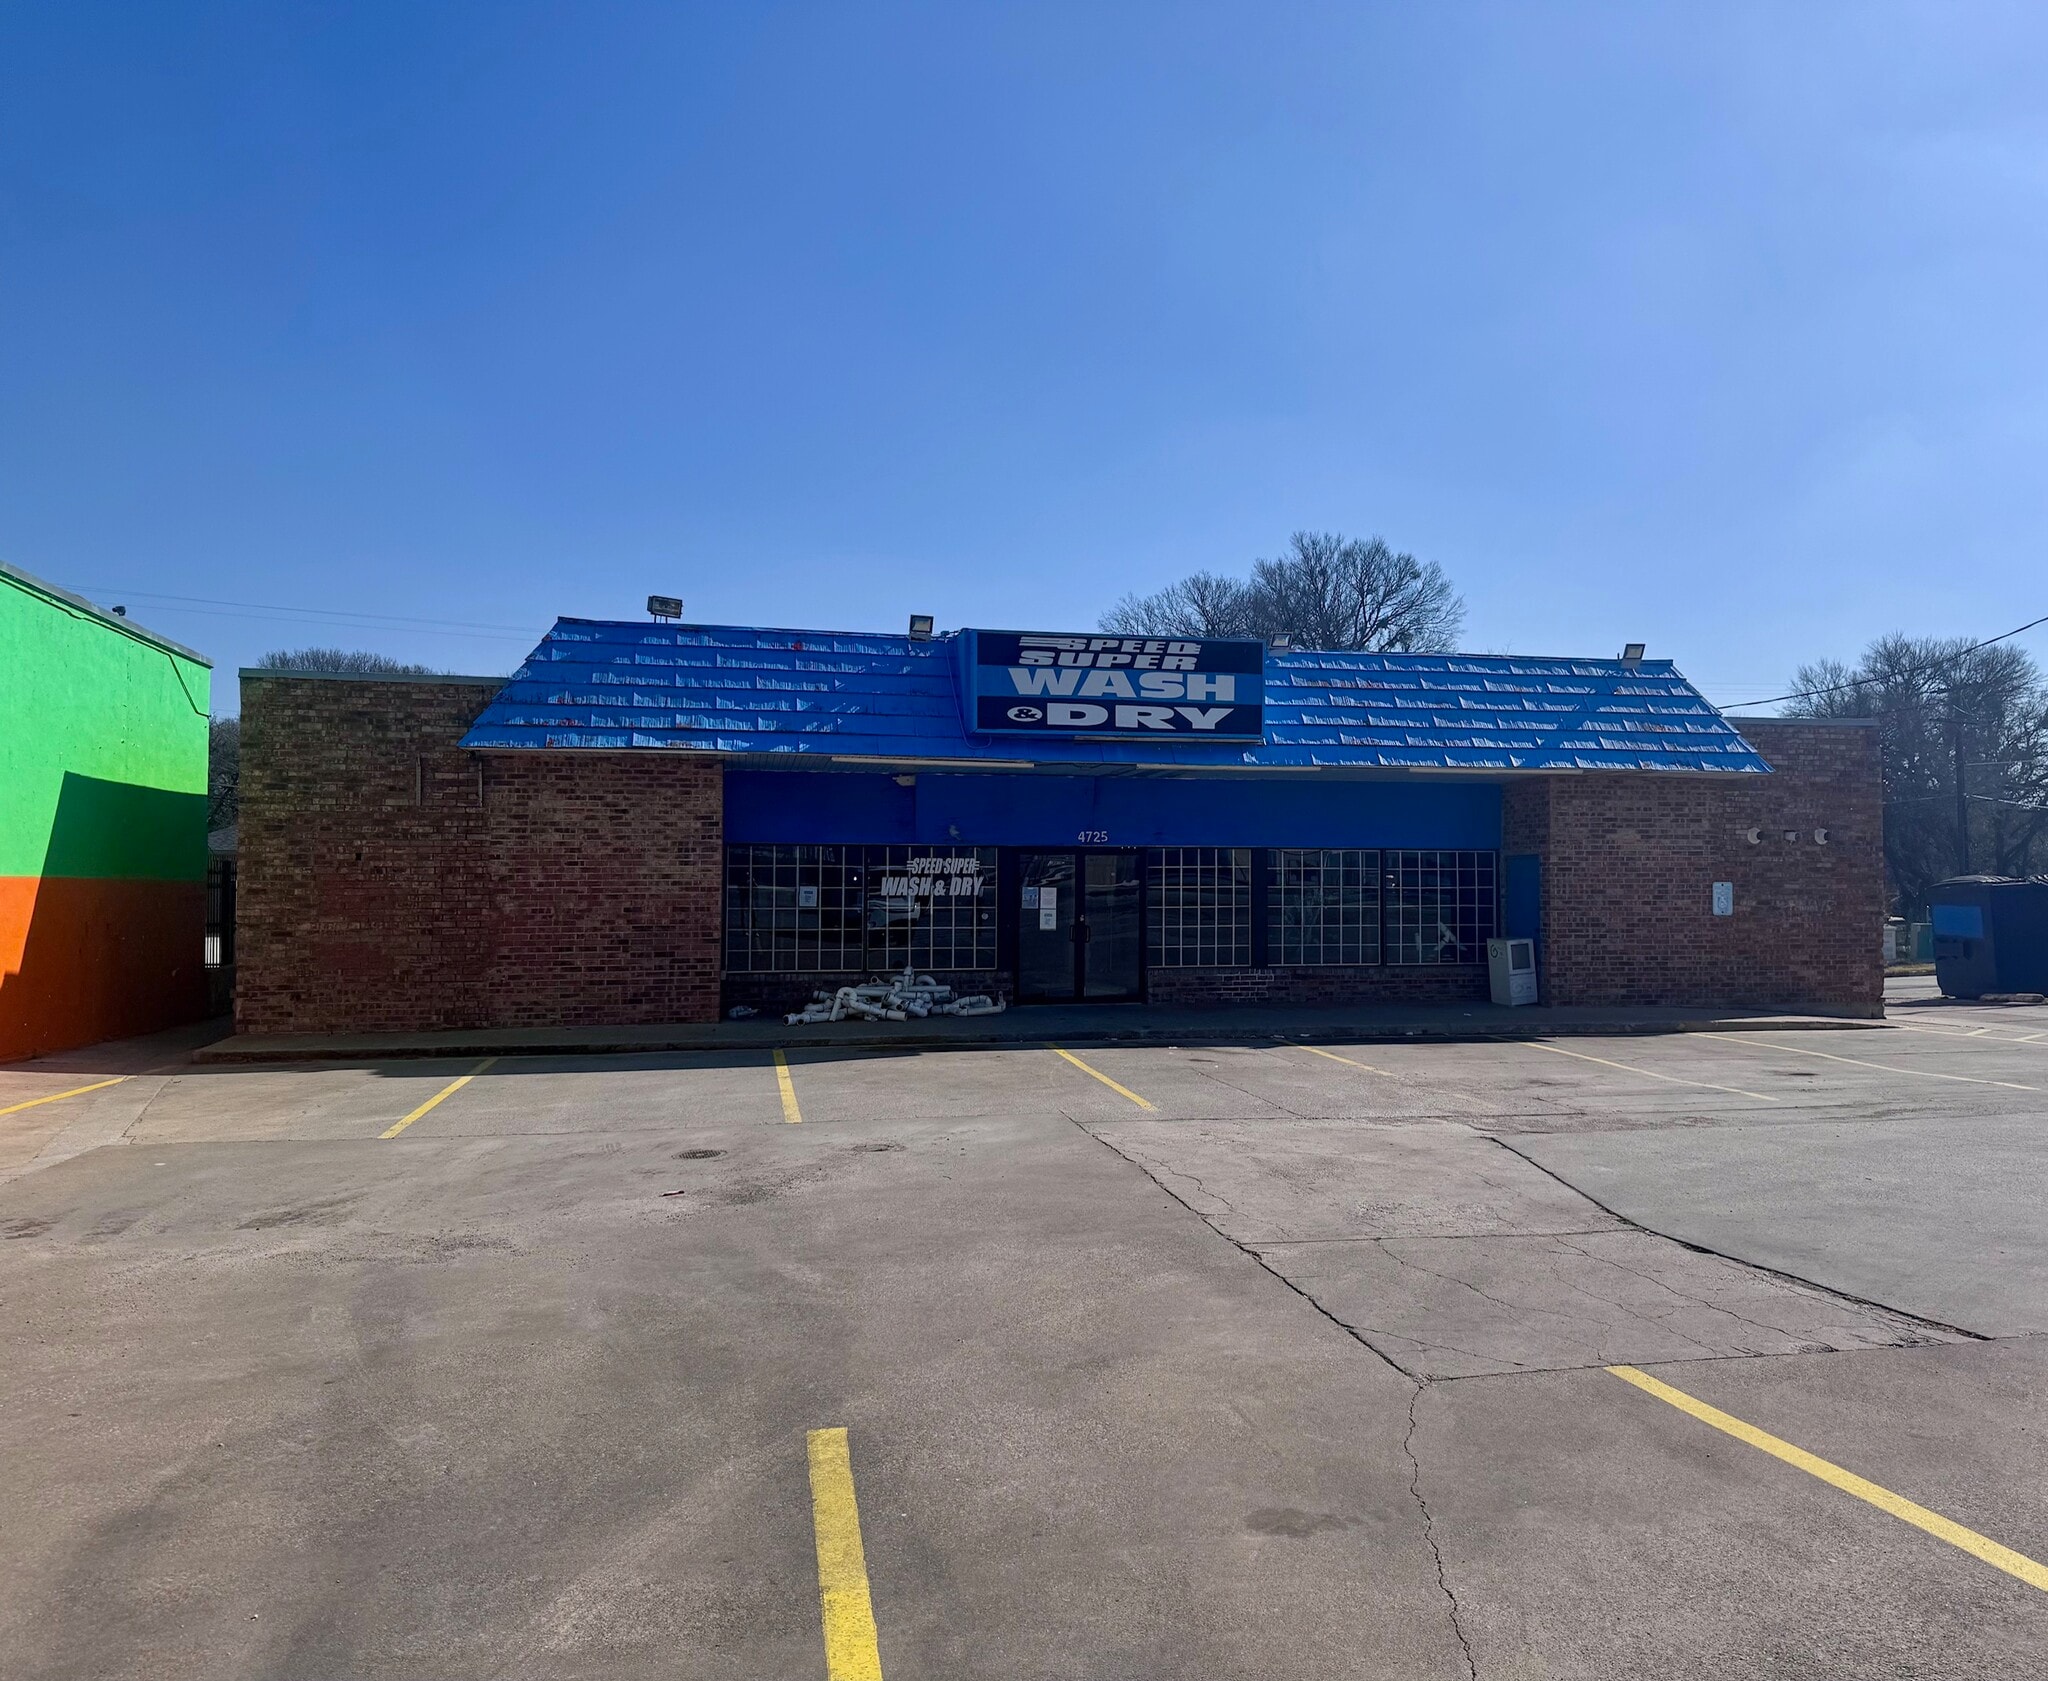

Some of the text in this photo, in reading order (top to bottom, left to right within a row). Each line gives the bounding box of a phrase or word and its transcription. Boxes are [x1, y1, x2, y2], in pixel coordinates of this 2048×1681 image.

[1019, 636, 1201, 655] SPEED
[1019, 651, 1198, 671] SUPER
[1008, 667, 1235, 701] WASH
[1011, 703, 1235, 730] & DRY
[1078, 831, 1108, 843] 4725
[909, 857, 978, 874] SPEED SUPER
[880, 876, 984, 896] WASH & DRY
